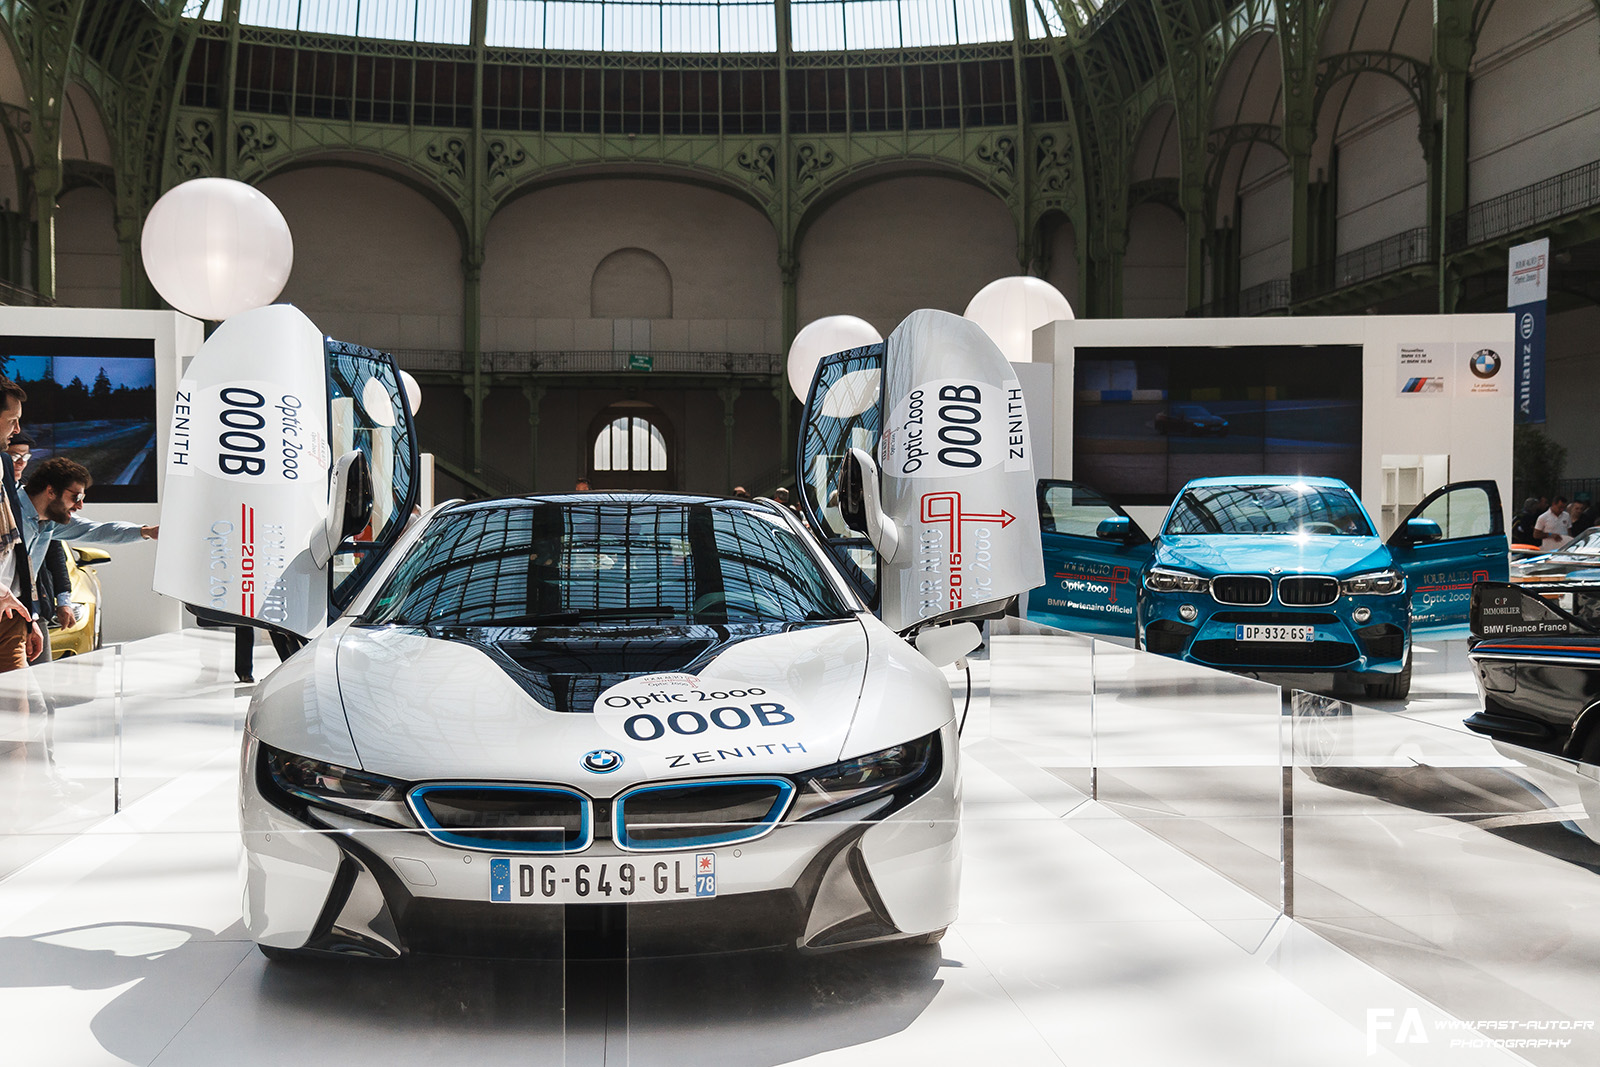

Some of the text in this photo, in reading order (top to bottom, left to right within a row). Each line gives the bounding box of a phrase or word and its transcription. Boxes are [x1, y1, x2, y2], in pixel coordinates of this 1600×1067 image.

[1520, 343, 1532, 414] Allianz
[174, 391, 190, 465] ZENITH
[218, 388, 266, 476] 000B
[274, 394, 303, 480] Optic 2000
[902, 390, 929, 474] Optic 2000
[938, 385, 982, 468] 000B
[1008, 388, 1024, 459] ZENITH
[203, 520, 234, 570] Optic
[919, 529, 944, 574] AUTO
[968, 528, 992, 572] 2000
[242, 545, 254, 592] 2015
[950, 553, 962, 600] 2015
[1061, 580, 1108, 594] Optic 2000
[1086, 564, 1110, 575] AUTO
[1048, 598, 1132, 614] BMW Partenaire Officiel
[1422, 592, 1470, 606] Optic 2000
[1483, 607, 1520, 615] IMMOBILIER
[1246, 627, 1304, 639] DP-932-GS
[1484, 623, 1567, 634] BMW Finance France
[604, 688, 766, 709] Optic 2000
[624, 702, 796, 741] 000B
[665, 742, 808, 768] ZENITH
[498, 861, 714, 897] F DG-649-GL 78
